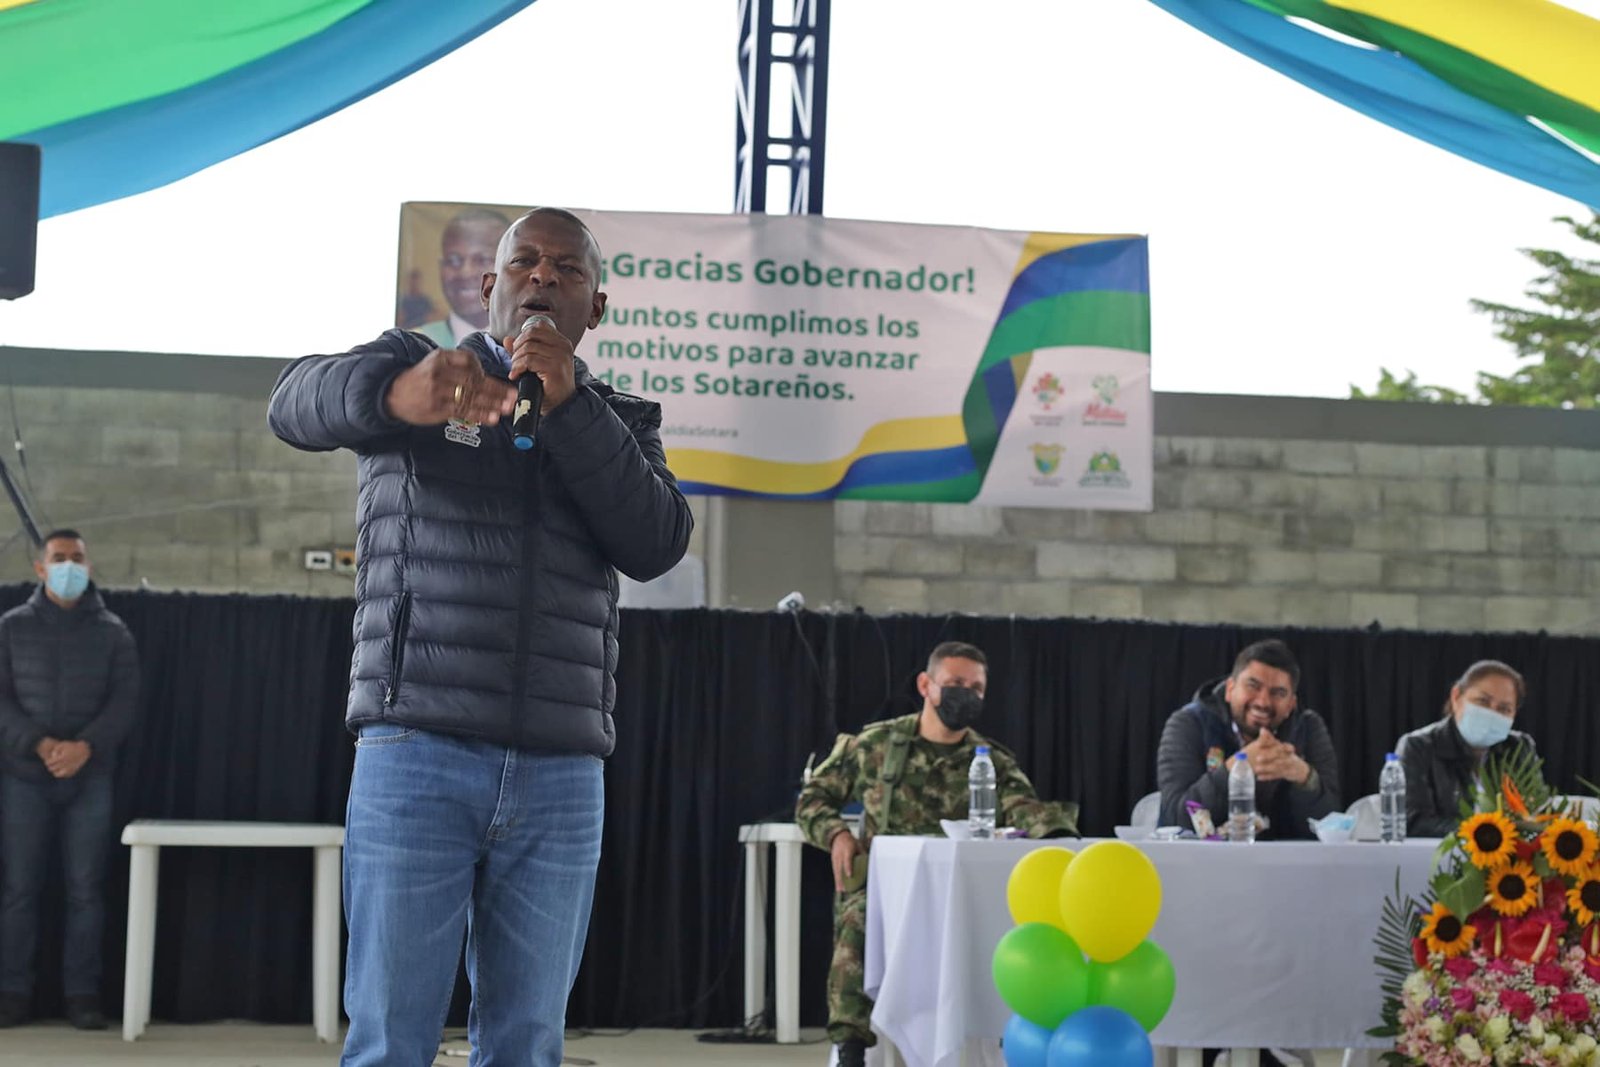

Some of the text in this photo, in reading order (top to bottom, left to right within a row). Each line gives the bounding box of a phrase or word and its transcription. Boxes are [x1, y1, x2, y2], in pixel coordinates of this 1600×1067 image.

[601, 253, 976, 293] ¡Gracias Gobernador!
[599, 304, 919, 338] Juntos cumplimos los
[597, 336, 918, 371] motivos para avanzar
[642, 369, 685, 394] los
[694, 372, 854, 401] Sotareños.
